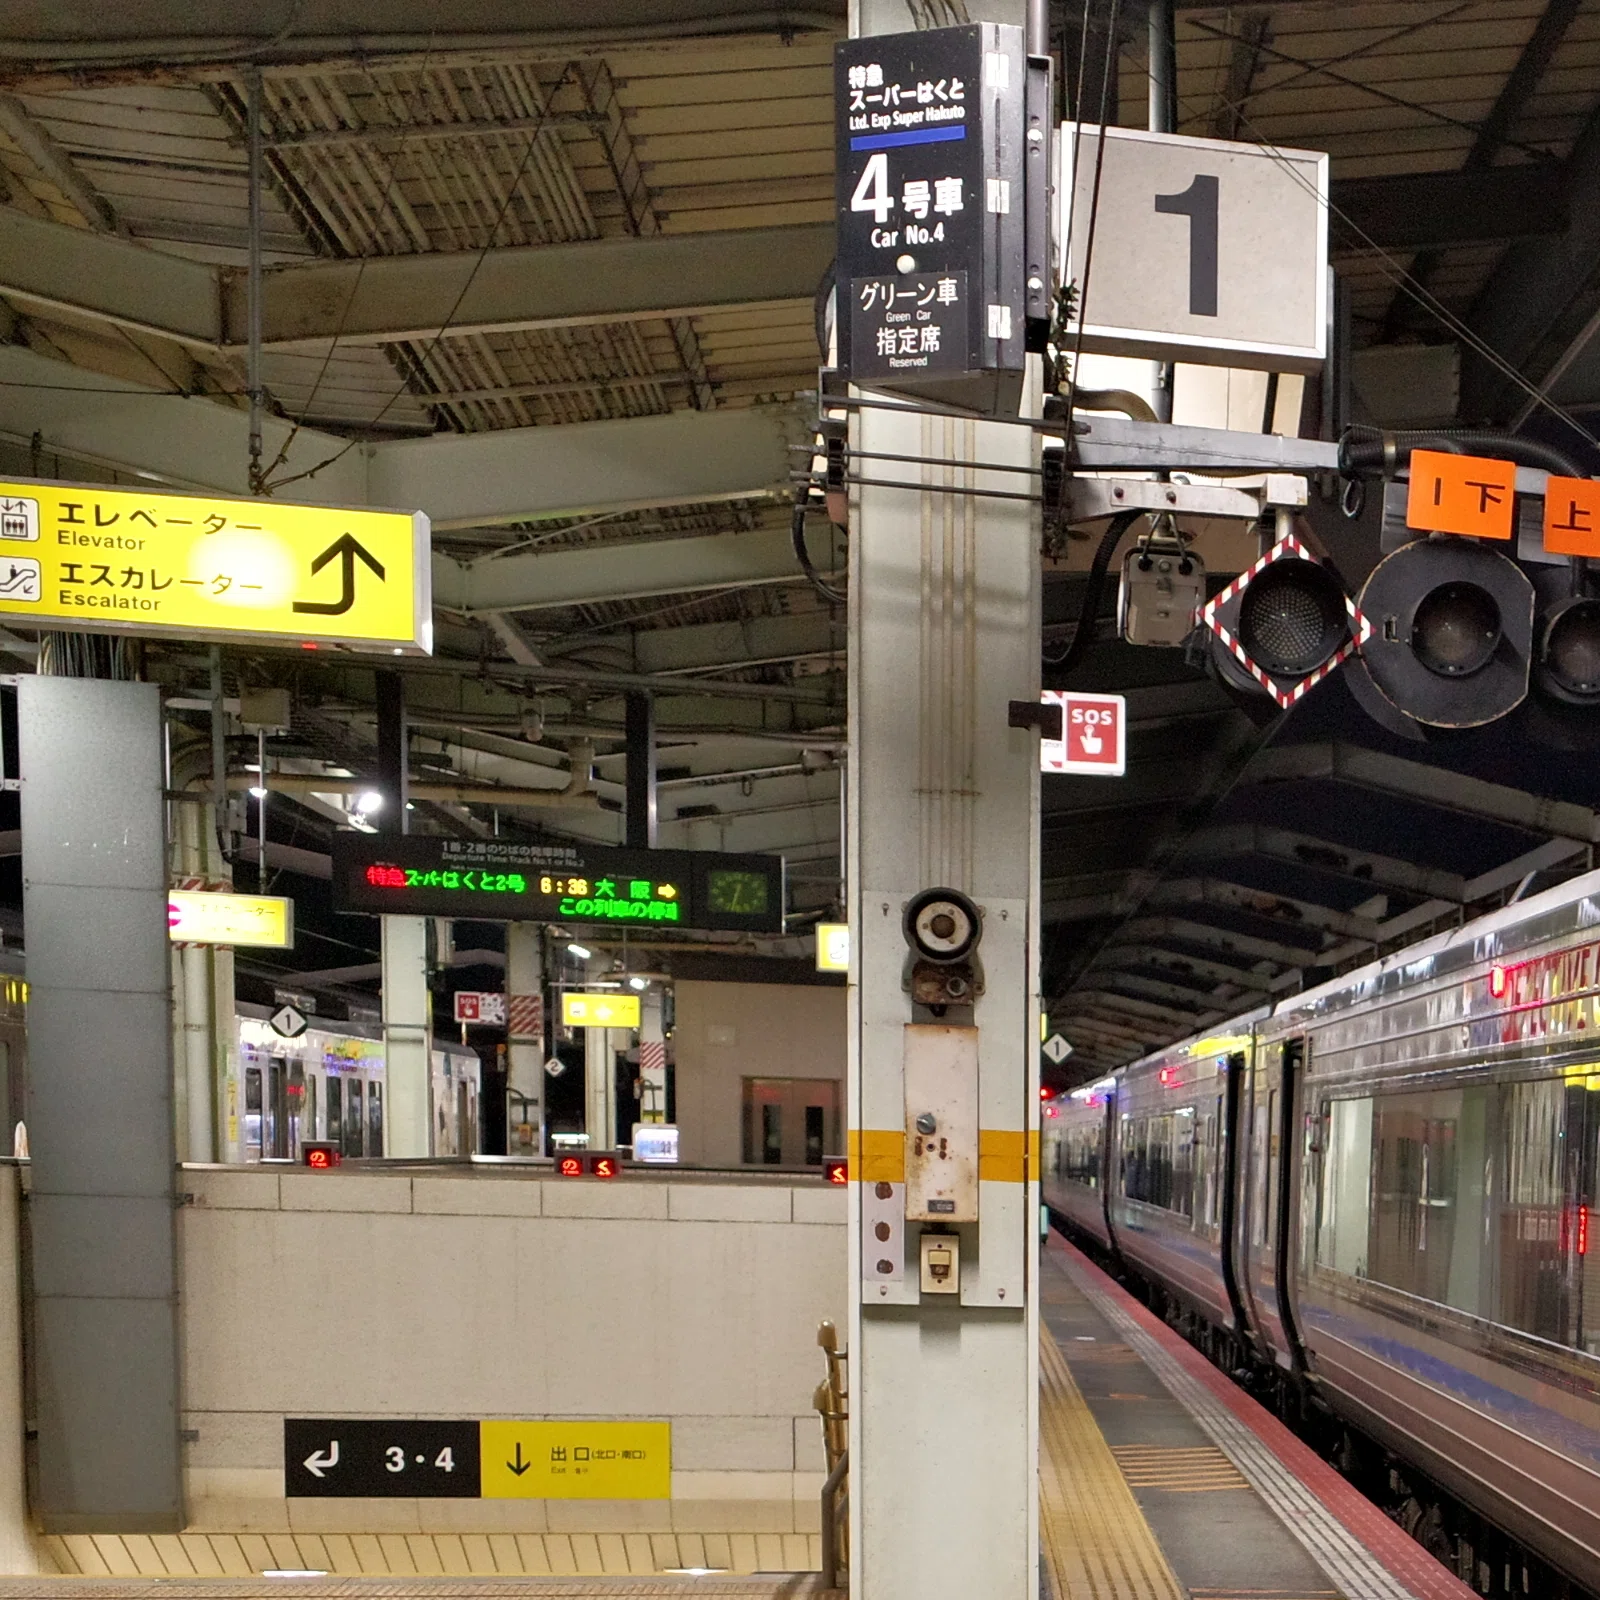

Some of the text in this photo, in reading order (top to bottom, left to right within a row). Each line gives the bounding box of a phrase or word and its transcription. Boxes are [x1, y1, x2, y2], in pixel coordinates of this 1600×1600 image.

[848, 63, 883, 89] 特急
[849, 77, 965, 111] スーパーはくと
[849, 105, 965, 131] Ltd. Exp Super Hakuto
[871, 222, 945, 248] Car No.4
[1154, 174, 1219, 318] 1
[860, 277, 959, 312] グリーン車
[886, 309, 931, 323] Green Car
[877, 325, 941, 356] 指定席
[889, 356, 928, 368] Reserved
[58, 502, 262, 535] エレベーター
[58, 530, 146, 551] Elevator
[59, 562, 263, 595] エスカレーター
[60, 590, 161, 611] Escalator
[1071, 709, 1112, 725] SOS
[285, 1013, 291, 1030] 1
